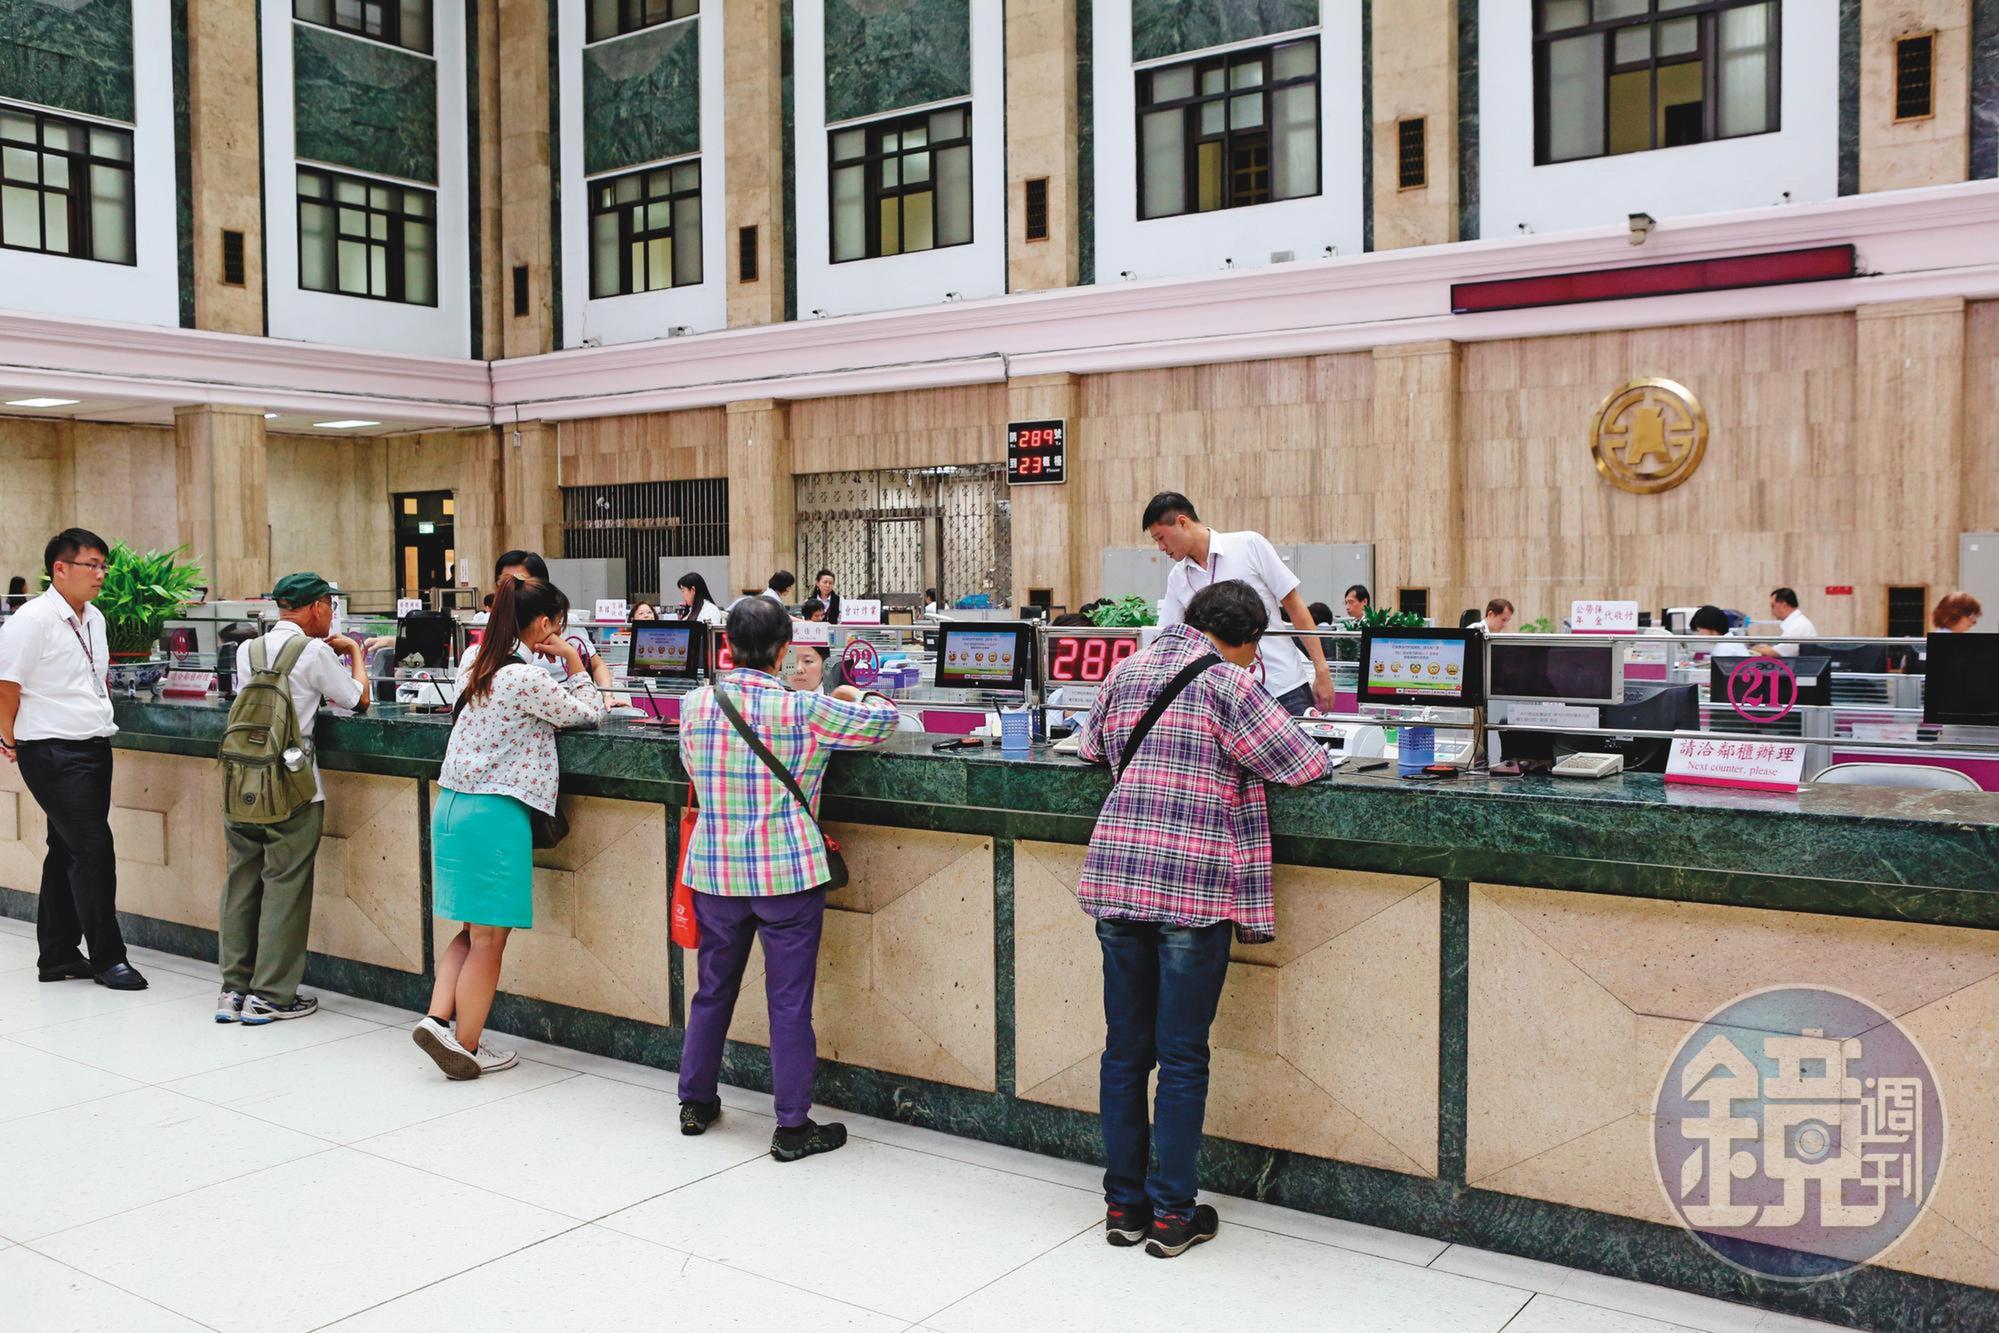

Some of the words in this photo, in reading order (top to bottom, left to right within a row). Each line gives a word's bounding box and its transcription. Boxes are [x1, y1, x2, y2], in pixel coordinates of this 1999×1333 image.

[1019, 429, 1053, 447] 289
[1019, 457, 1042, 474] 23
[845, 606, 877, 616] 會計作業
[849, 648, 873, 679] 23
[1741, 667, 1783, 708] 21
[1680, 739, 1796, 762] 請洽鄰櫃辦理
[1688, 761, 1708, 771] Next
[1710, 763, 1747, 775] counter,
[1749, 765, 1778, 777] please
